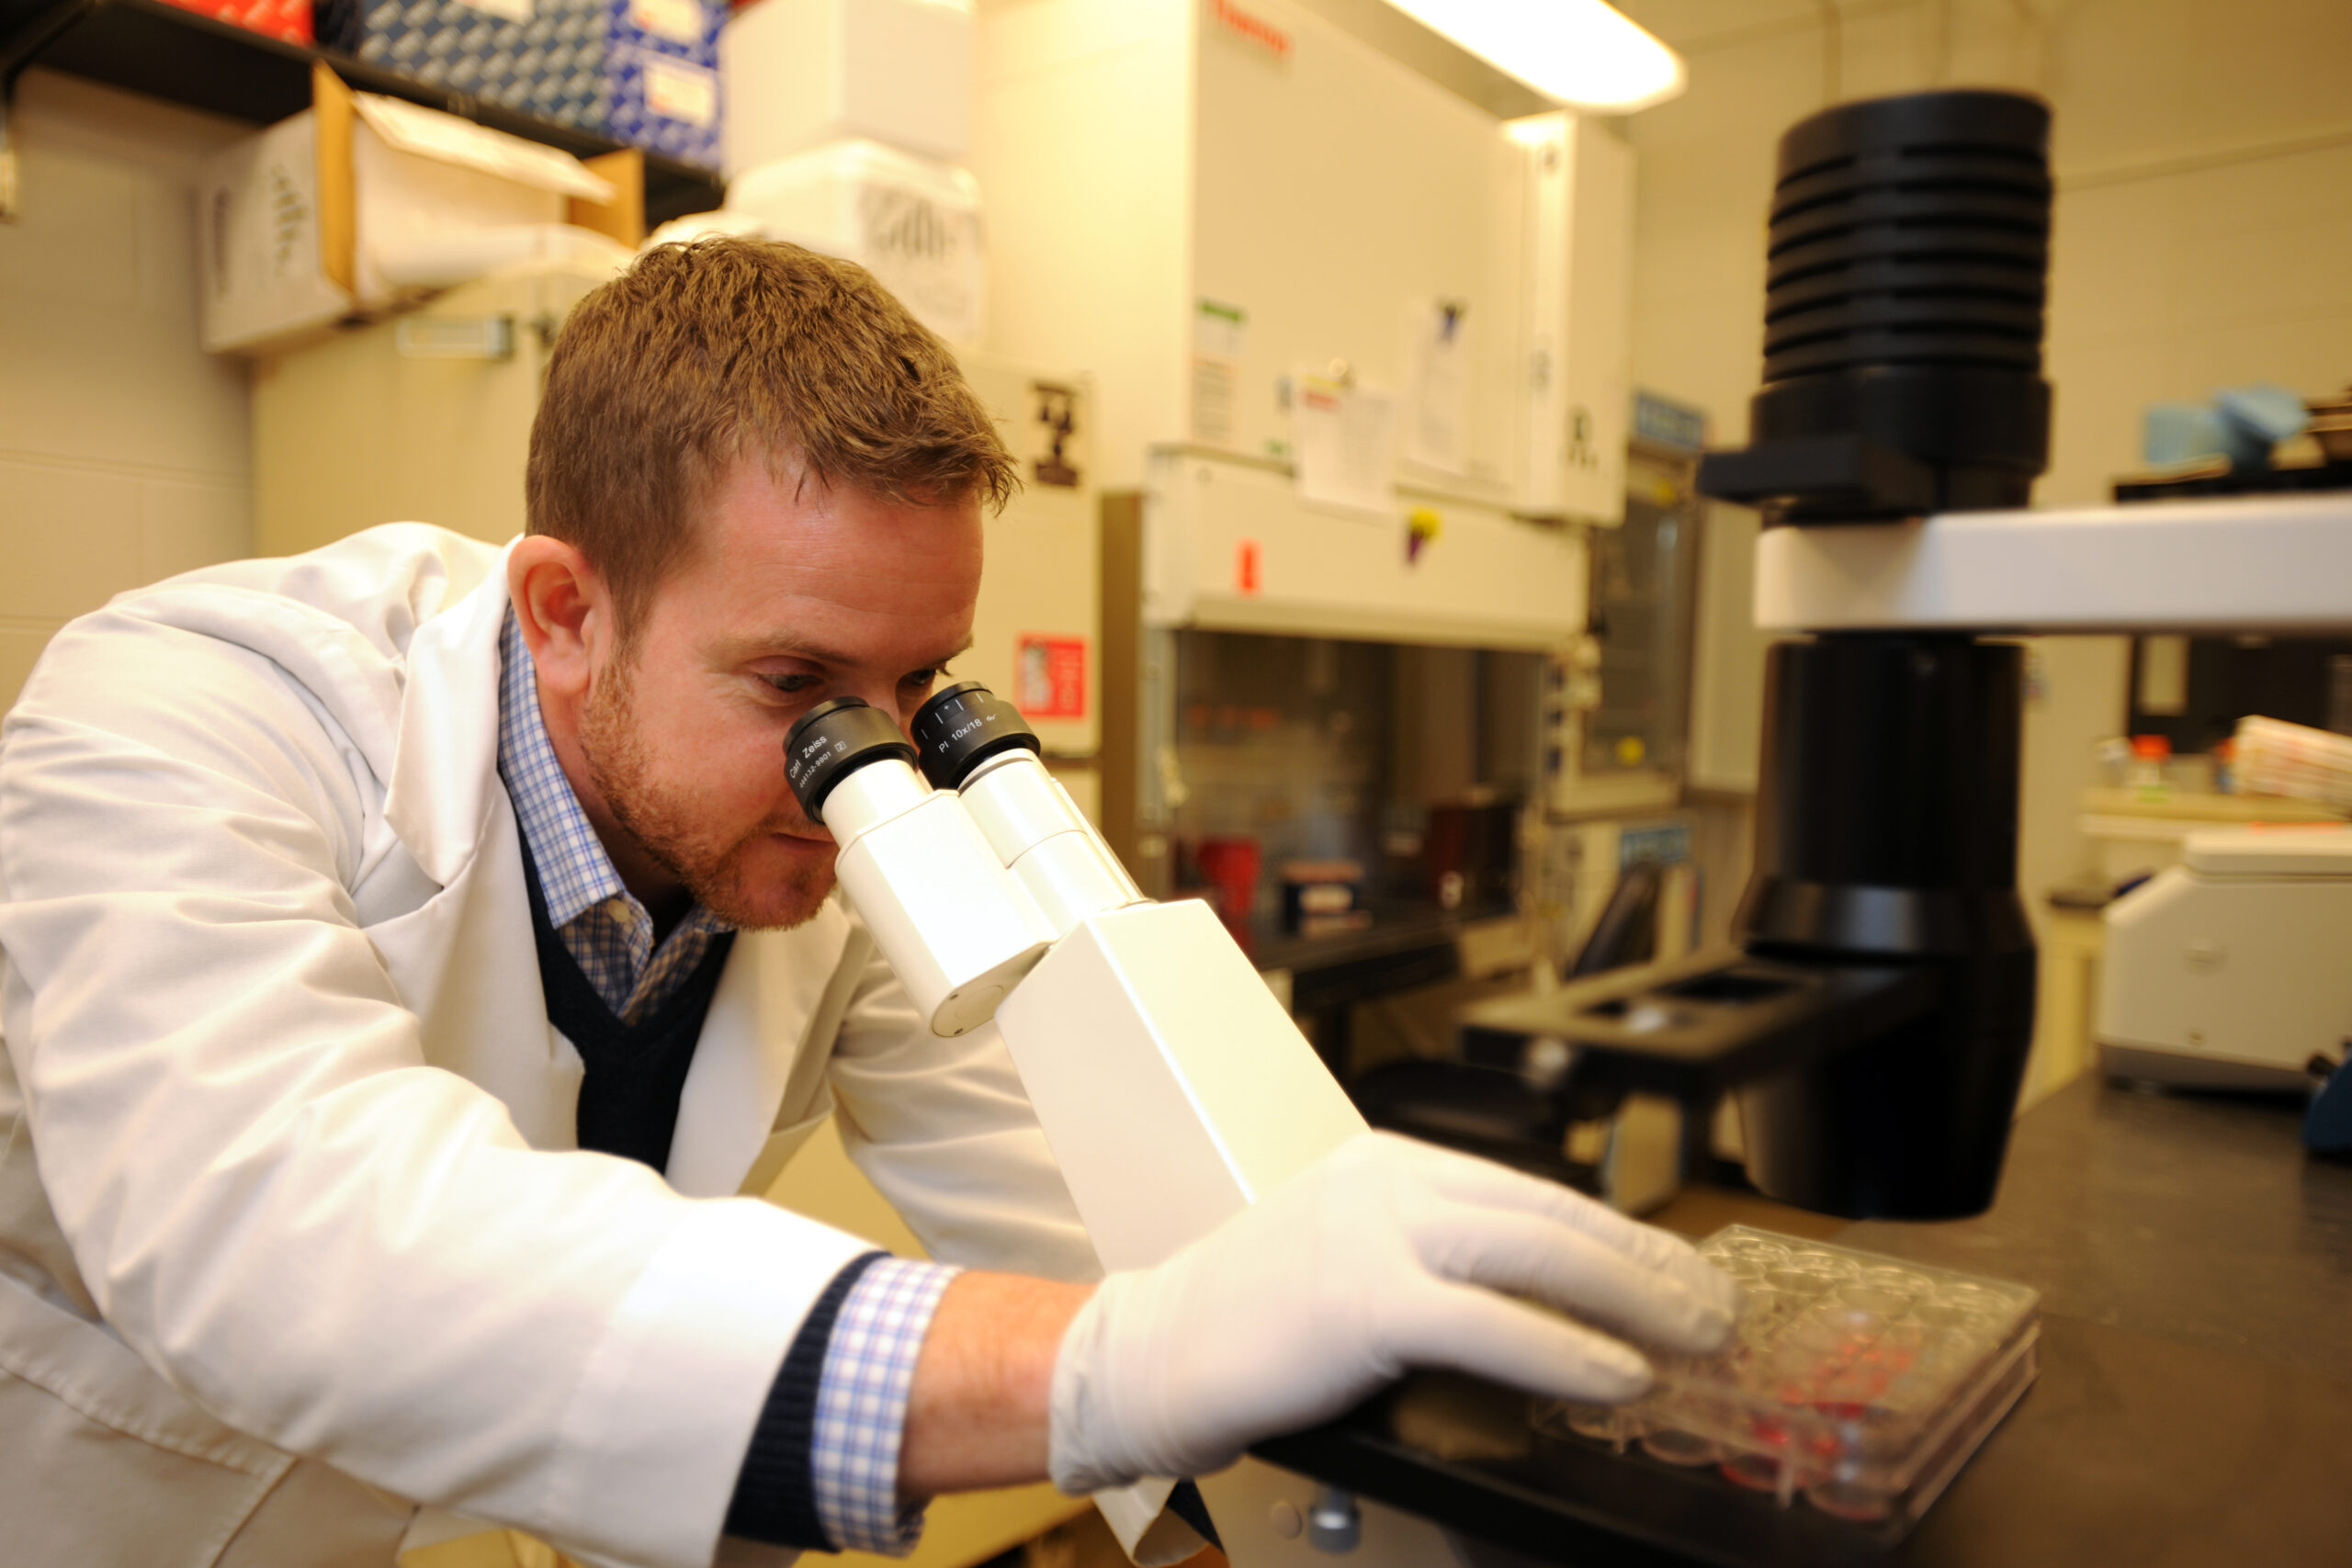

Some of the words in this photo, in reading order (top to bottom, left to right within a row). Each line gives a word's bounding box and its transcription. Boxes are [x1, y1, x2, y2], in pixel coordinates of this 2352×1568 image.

[951, 718, 982, 740] 10x/18
[789, 759, 801, 779] Carl
[802, 736, 827, 759] Zeiss
